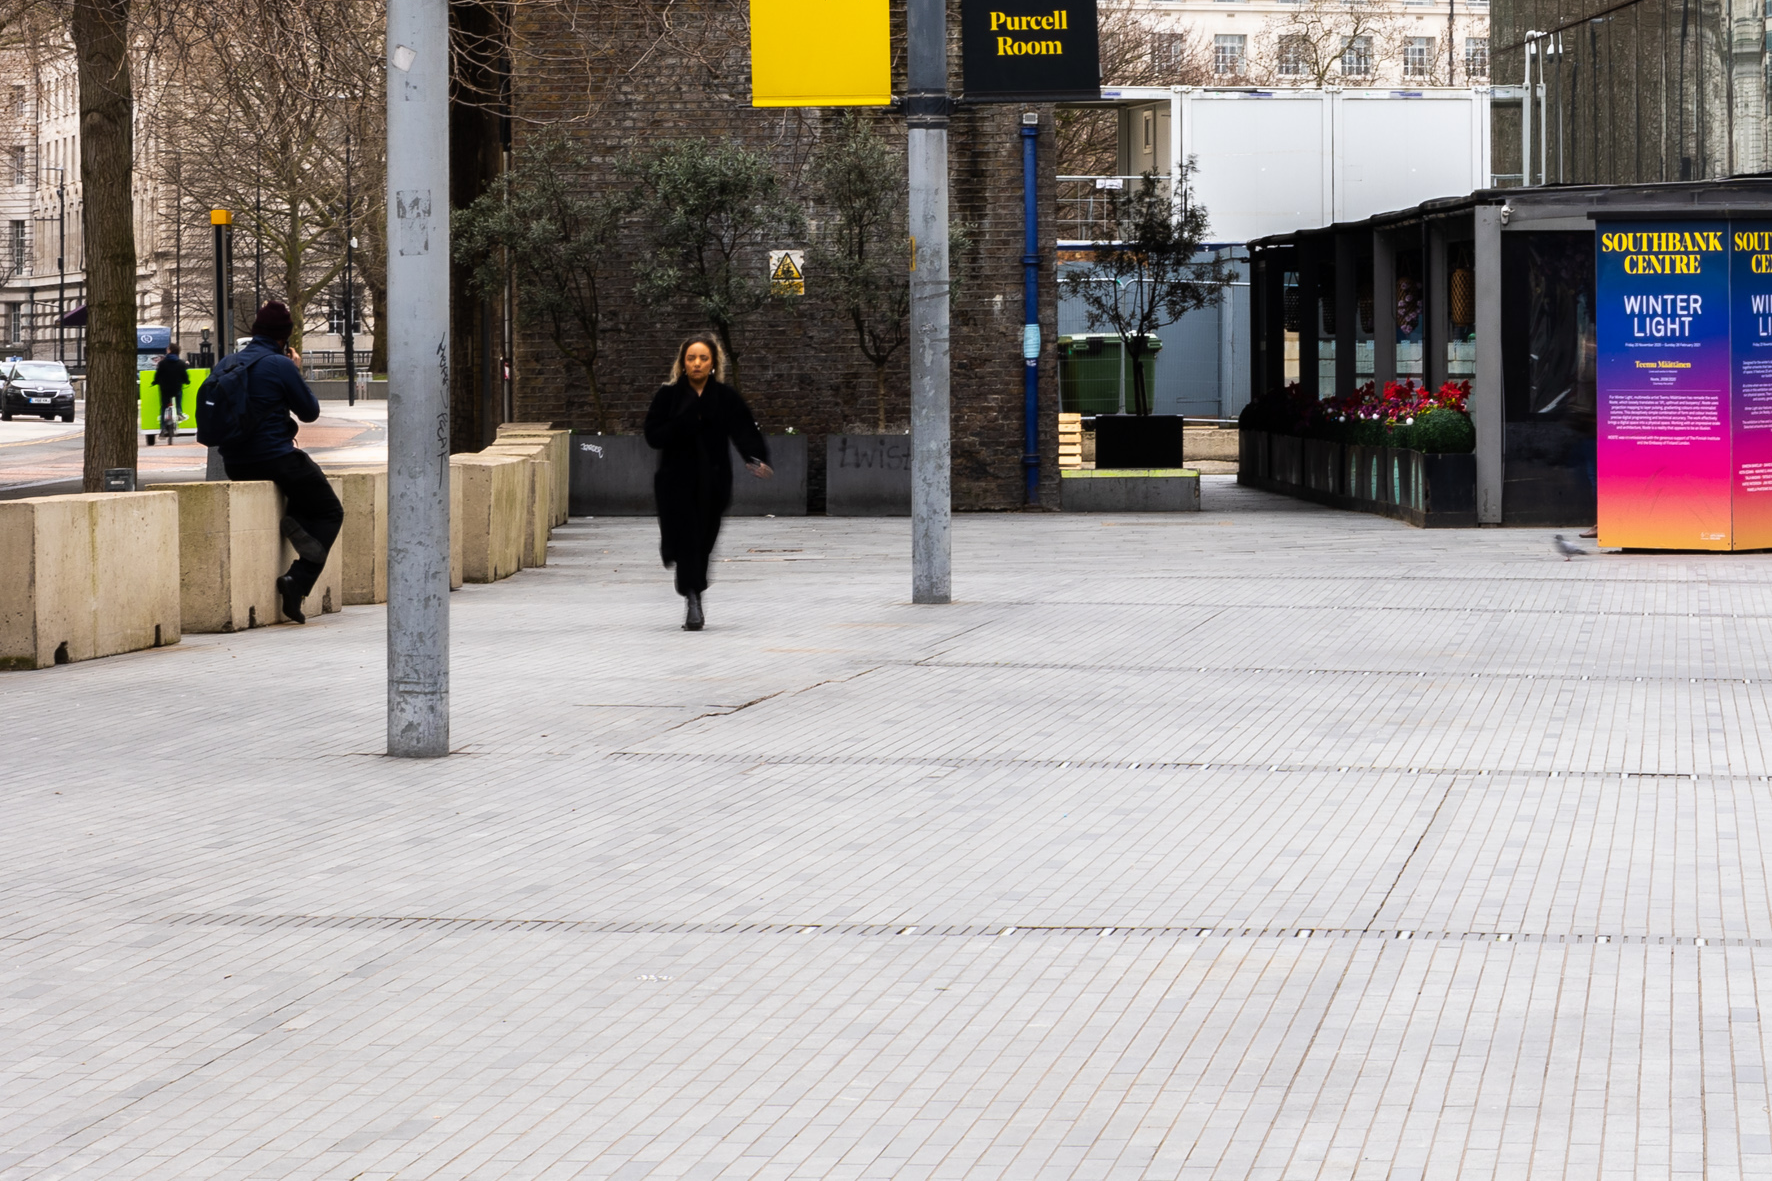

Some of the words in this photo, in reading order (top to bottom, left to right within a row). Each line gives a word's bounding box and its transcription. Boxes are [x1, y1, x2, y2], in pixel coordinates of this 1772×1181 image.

[990, 10, 1067, 31] Purcell
[997, 36, 1063, 56] Room
[1602, 232, 1723, 252] SOUTHBANK
[1624, 255, 1701, 274] CENTRE
[1624, 295, 1702, 315] WINTER
[1634, 317, 1693, 337] LIGHT
[1635, 360, 1657, 368] Teemu
